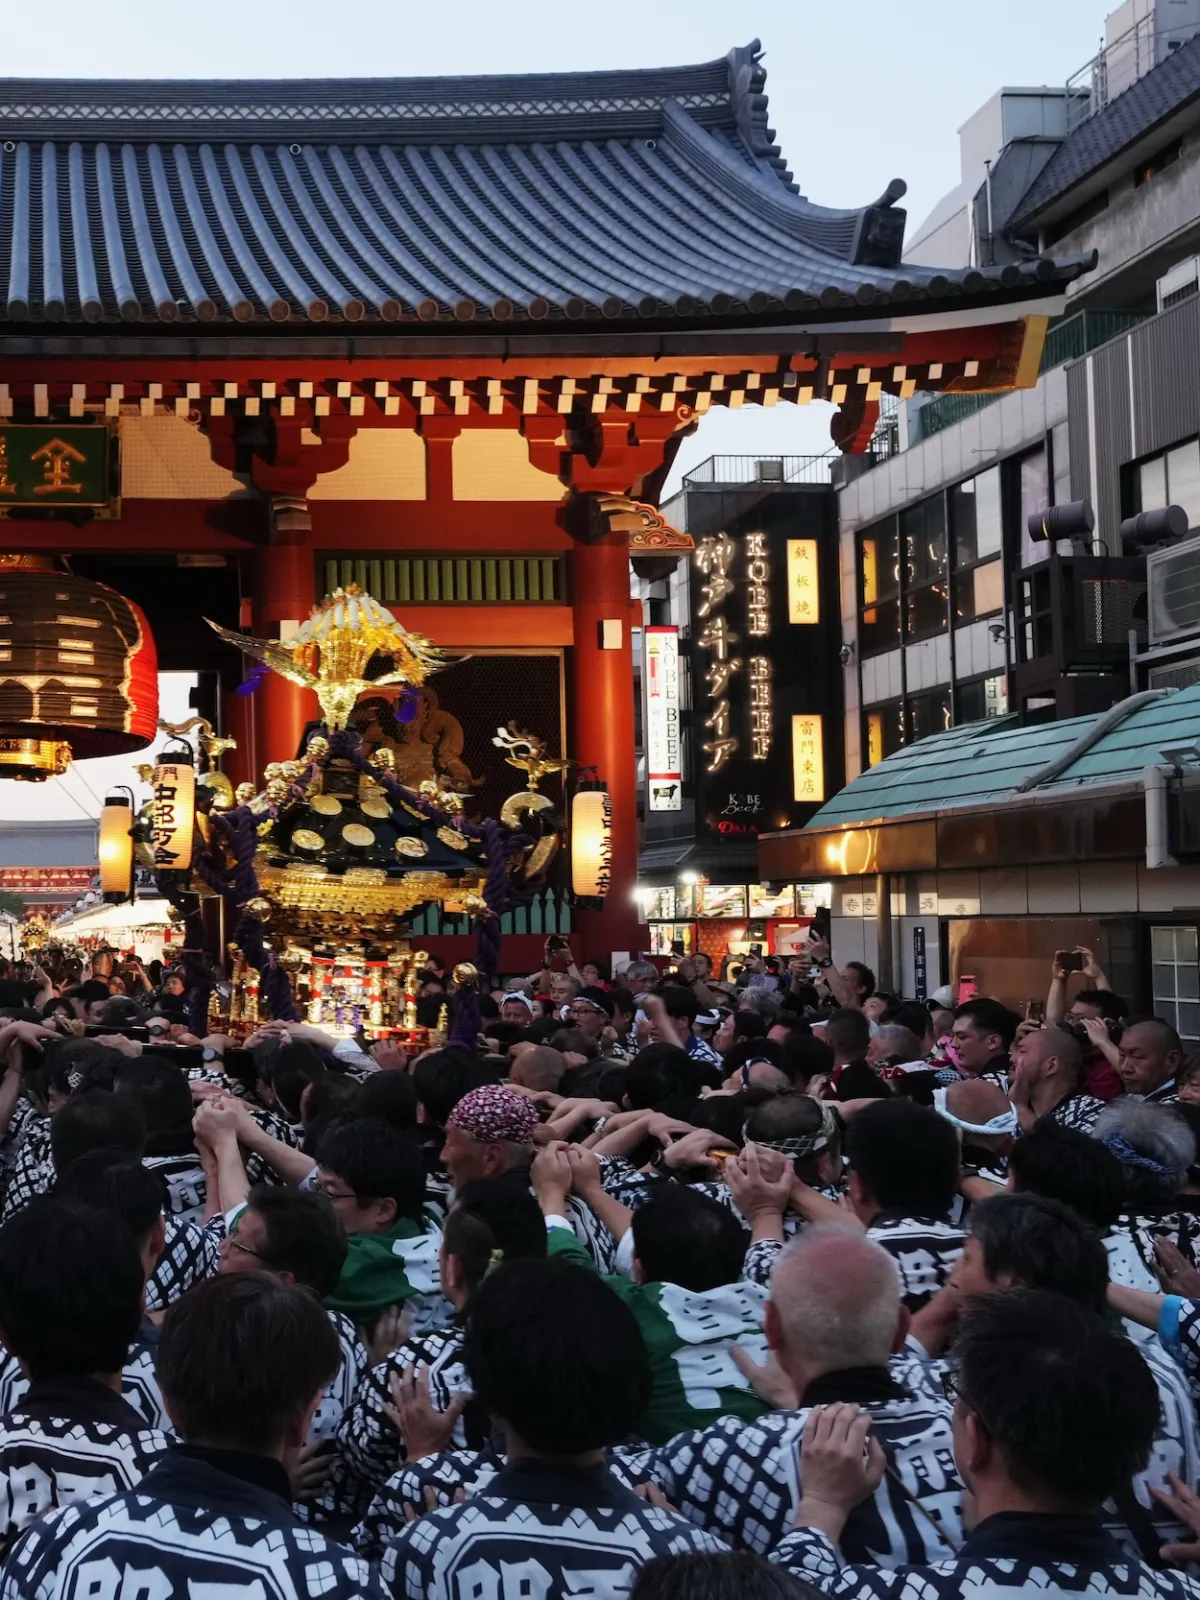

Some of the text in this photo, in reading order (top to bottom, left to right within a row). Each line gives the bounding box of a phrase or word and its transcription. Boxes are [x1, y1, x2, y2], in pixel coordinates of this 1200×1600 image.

[663, 636, 678, 771] KOBE BEEF
[746, 532, 773, 761] KOBE BEEF
[800, 720, 816, 794] 雷門東店
